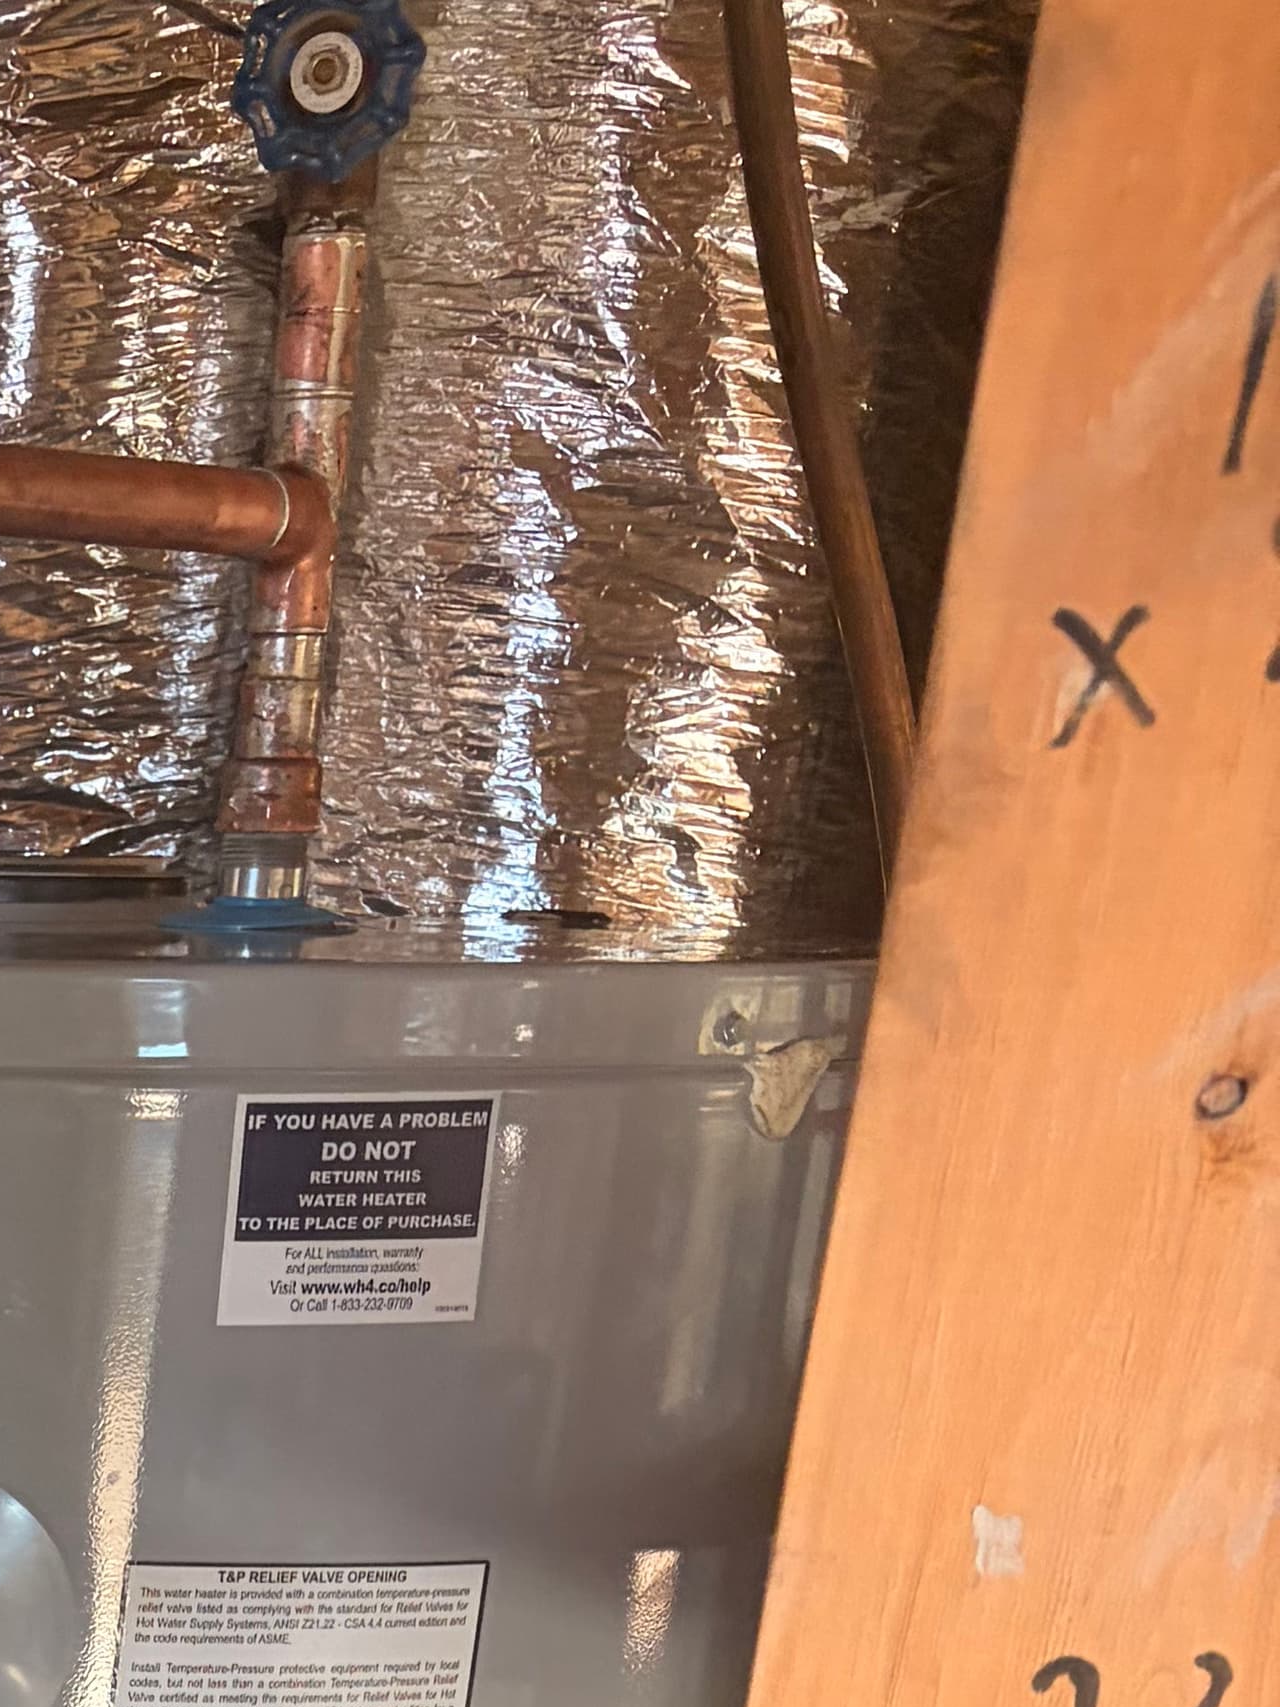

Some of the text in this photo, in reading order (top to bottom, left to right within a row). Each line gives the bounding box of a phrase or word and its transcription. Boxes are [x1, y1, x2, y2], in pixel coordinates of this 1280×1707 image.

[247, 1111, 490, 1129] IF YOU HAVE A PROBLEM
[321, 1140, 415, 1160] DO NOT
[309, 1169, 421, 1183] RETURN THIS
[298, 1192, 426, 1206] WATER HEATER
[239, 1214, 478, 1230] TO THE PLACE OF PURCHASE.
[284, 1247, 423, 1259] For ALL installation, warranty
[285, 1261, 419, 1276] and performance questions:
[269, 1278, 431, 1294] Visit www.wh4.co/help
[289, 1298, 304, 1312] Or
[306, 1298, 328, 1311] Call
[218, 1570, 407, 1583] T&P RELIEF VALVE OPENING
[141, 1586, 161, 1597] This
[163, 1589, 192, 1598] water
[194, 1589, 226, 1598] heater
[228, 1589, 238, 1599] is
[239, 1589, 283, 1599] provided
[285, 1589, 305, 1598] with
[307, 1590, 315, 1599] a
[316, 1589, 374, 1599] combination
[133, 1632, 291, 1644] the code requirements of ASME.
